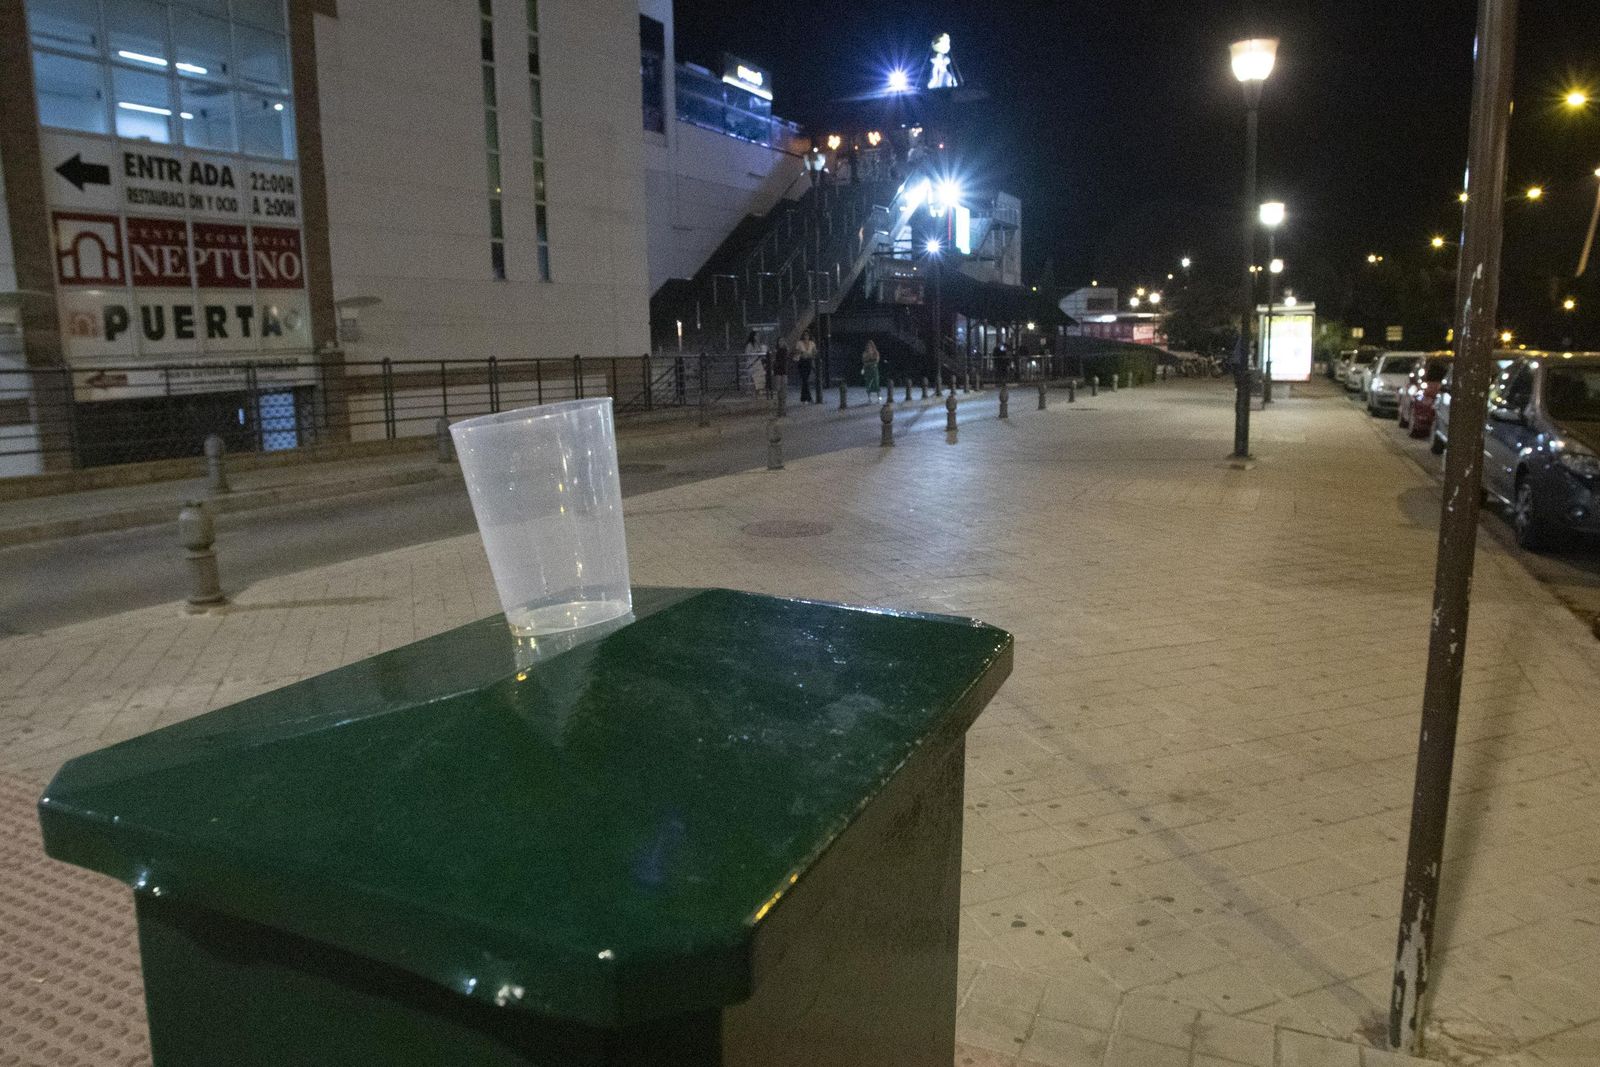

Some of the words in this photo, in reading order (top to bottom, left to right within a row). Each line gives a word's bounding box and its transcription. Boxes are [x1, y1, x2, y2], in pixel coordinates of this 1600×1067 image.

[124, 152, 235, 189] ENTRADA
[250, 172, 295, 195] 22:00H
[216, 197, 238, 213] OCIO
[252, 195, 261, 215] A
[264, 197, 296, 218] 2:00H
[131, 243, 301, 281] NEPTUNO
[104, 304, 282, 342] PUERTA
